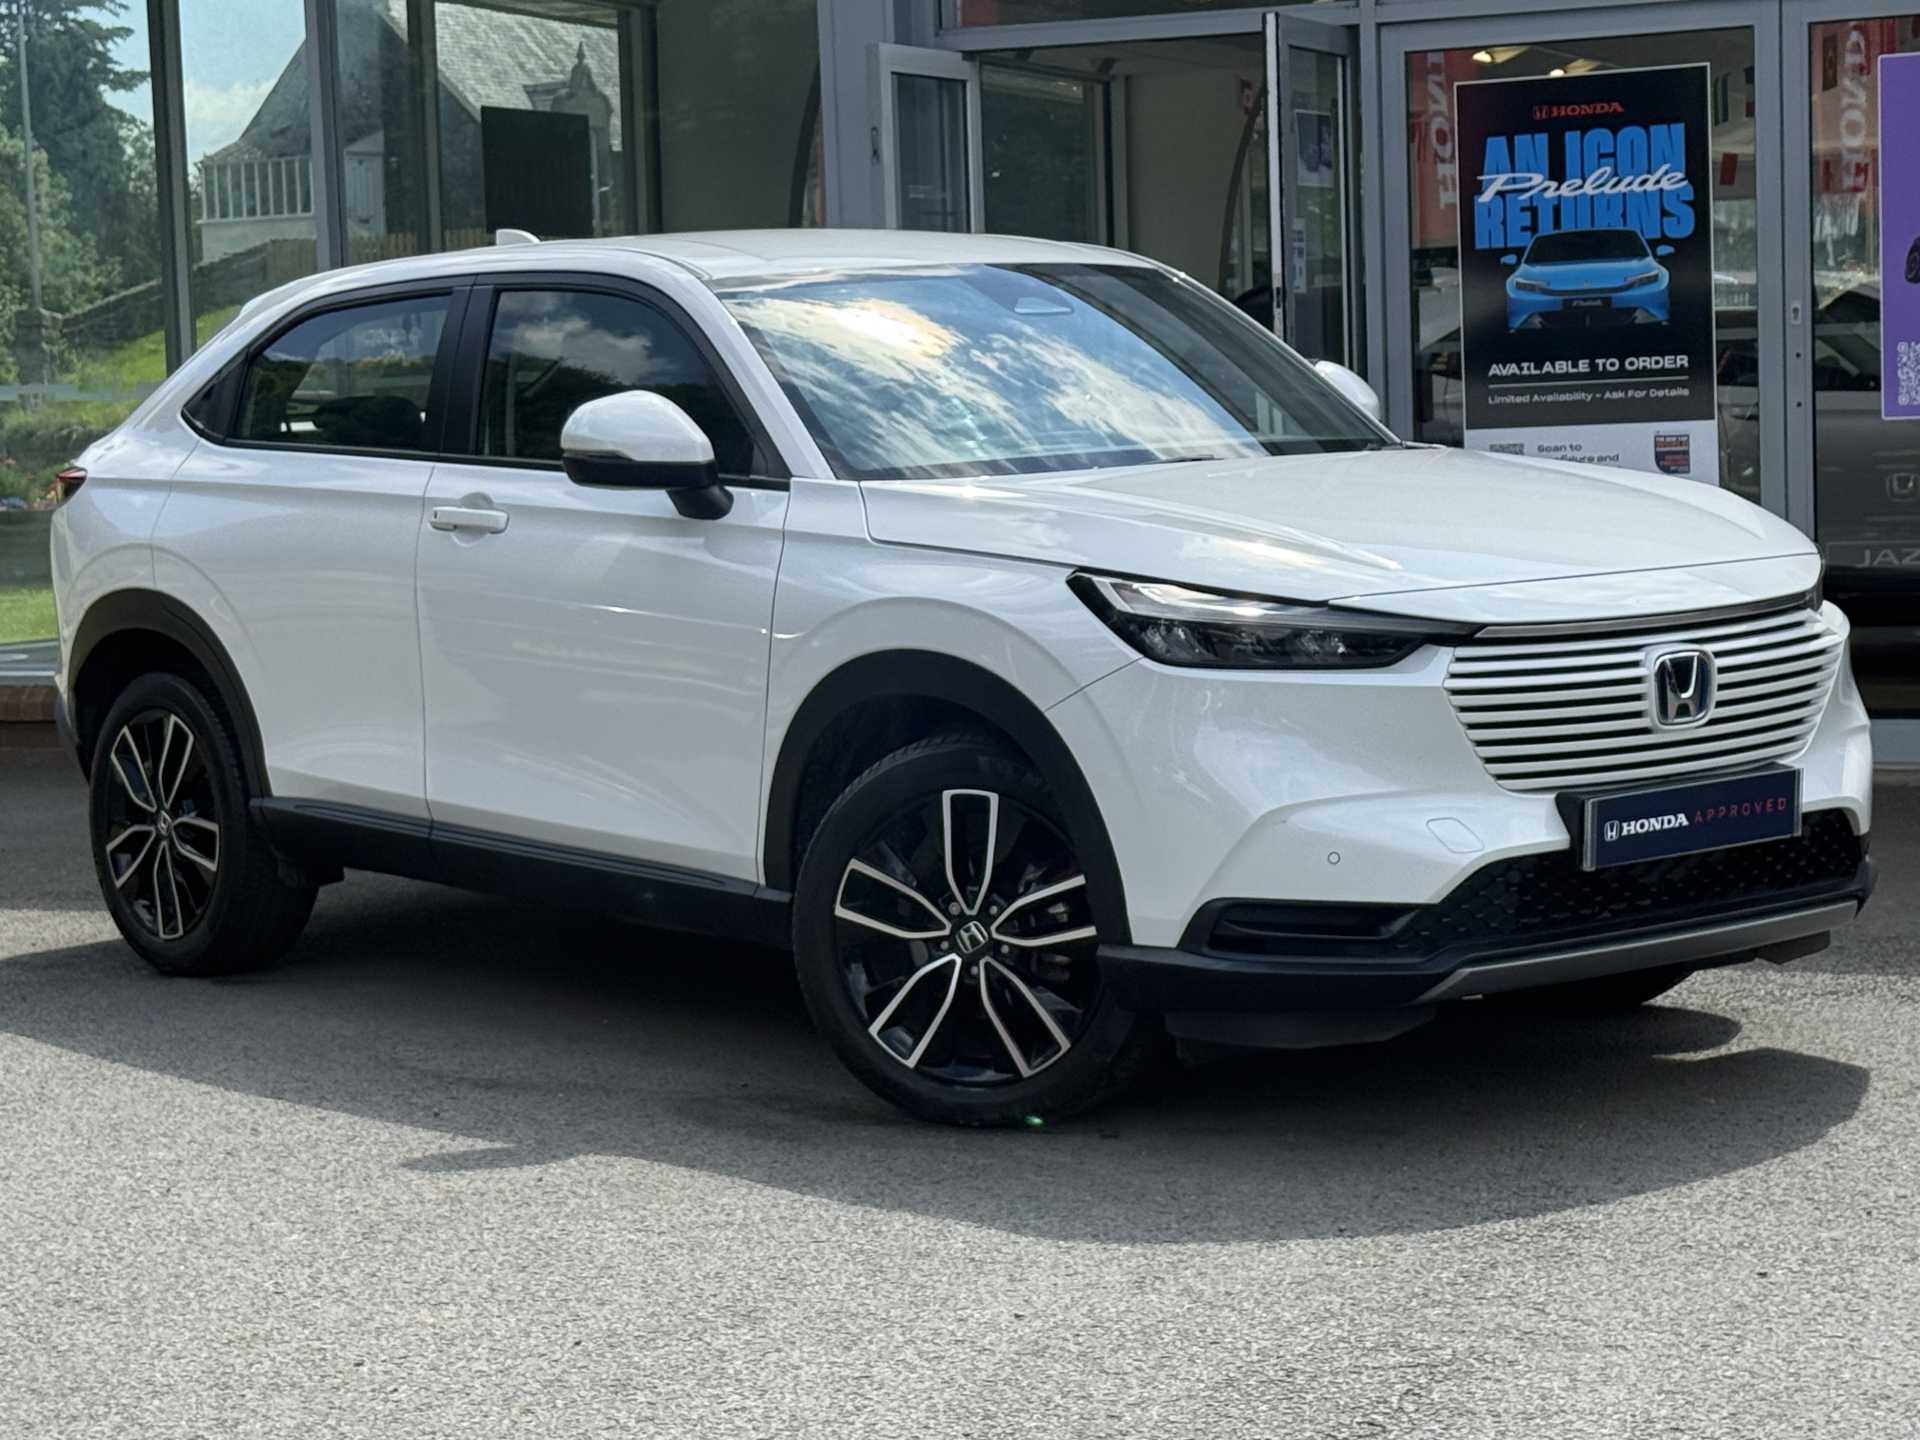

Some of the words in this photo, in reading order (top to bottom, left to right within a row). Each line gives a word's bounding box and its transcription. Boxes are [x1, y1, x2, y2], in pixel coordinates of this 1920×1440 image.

[1550, 102, 1624, 117] HONDA
[1481, 132, 1549, 192] AN
[1564, 122, 1687, 183] ICON
[1476, 163, 1689, 203] Prelude
[1474, 183, 1696, 250] RETURNS
[1488, 359, 1591, 378] AVAILABLE
[1595, 357, 1620, 372] TO
[1624, 354, 1690, 371] ORDER
[1488, 393, 1530, 405] Limited
[1532, 390, 1593, 403] Availability
[1604, 389, 1625, 399] Ask
[1628, 388, 1647, 398] For
[1650, 386, 1690, 397] Details
[1537, 444, 1567, 453] Scan
[1569, 443, 1583, 452] to
[1596, 453, 1620, 463] and
[1621, 813, 1689, 835] HONDA
[1694, 798, 1787, 822] APPROVED
